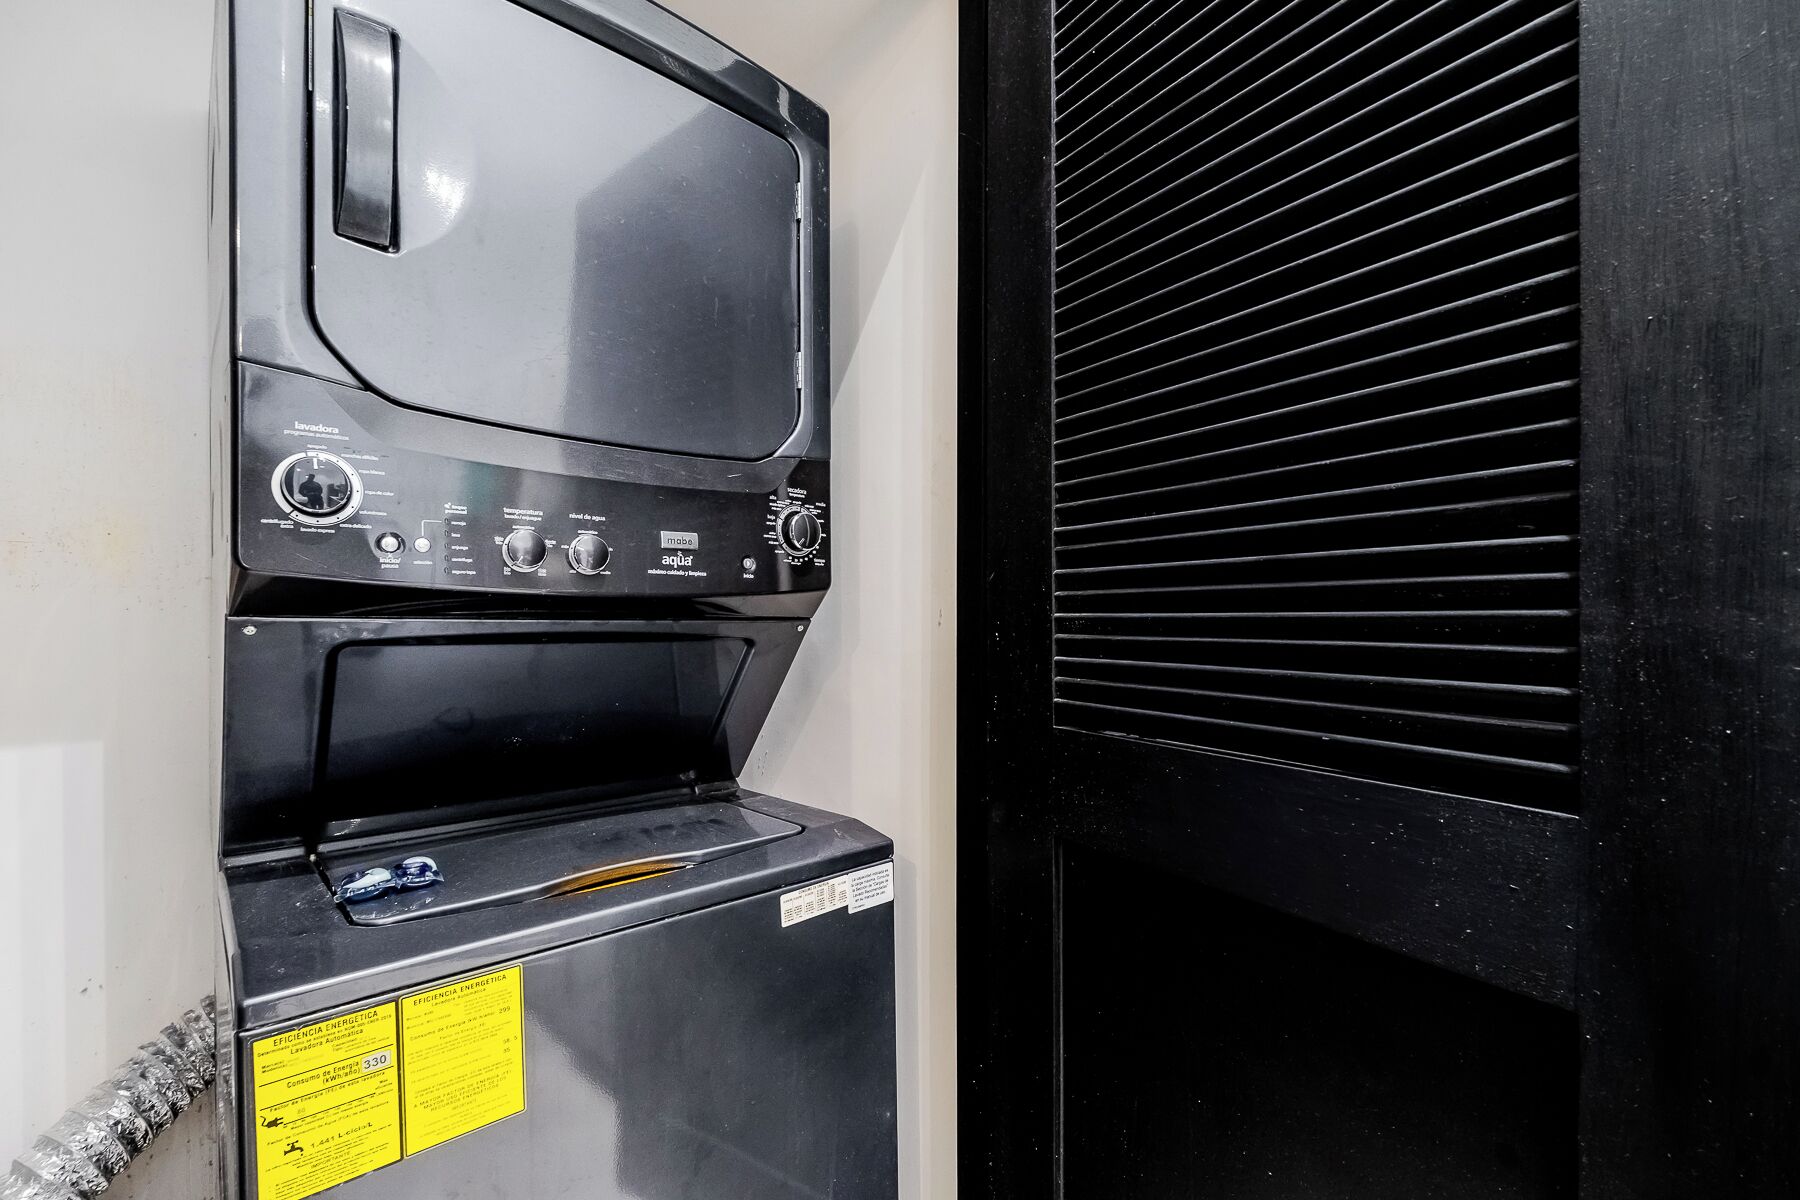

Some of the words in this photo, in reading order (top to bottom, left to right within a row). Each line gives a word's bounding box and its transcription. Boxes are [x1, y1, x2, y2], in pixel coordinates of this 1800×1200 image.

[295, 421, 339, 433] lavadora
[503, 507, 544, 516] temperatura
[667, 536, 692, 545] mabe
[413, 989, 458, 1006] EFICIENCIA
[498, 1006, 511, 1014] 299
[273, 1027, 323, 1046] EFICIENCIA
[257, 1045, 291, 1057] Determinado
[290, 1041, 323, 1055] Lavadora
[364, 1054, 387, 1070] 330
[286, 1074, 320, 1089] Consumo
